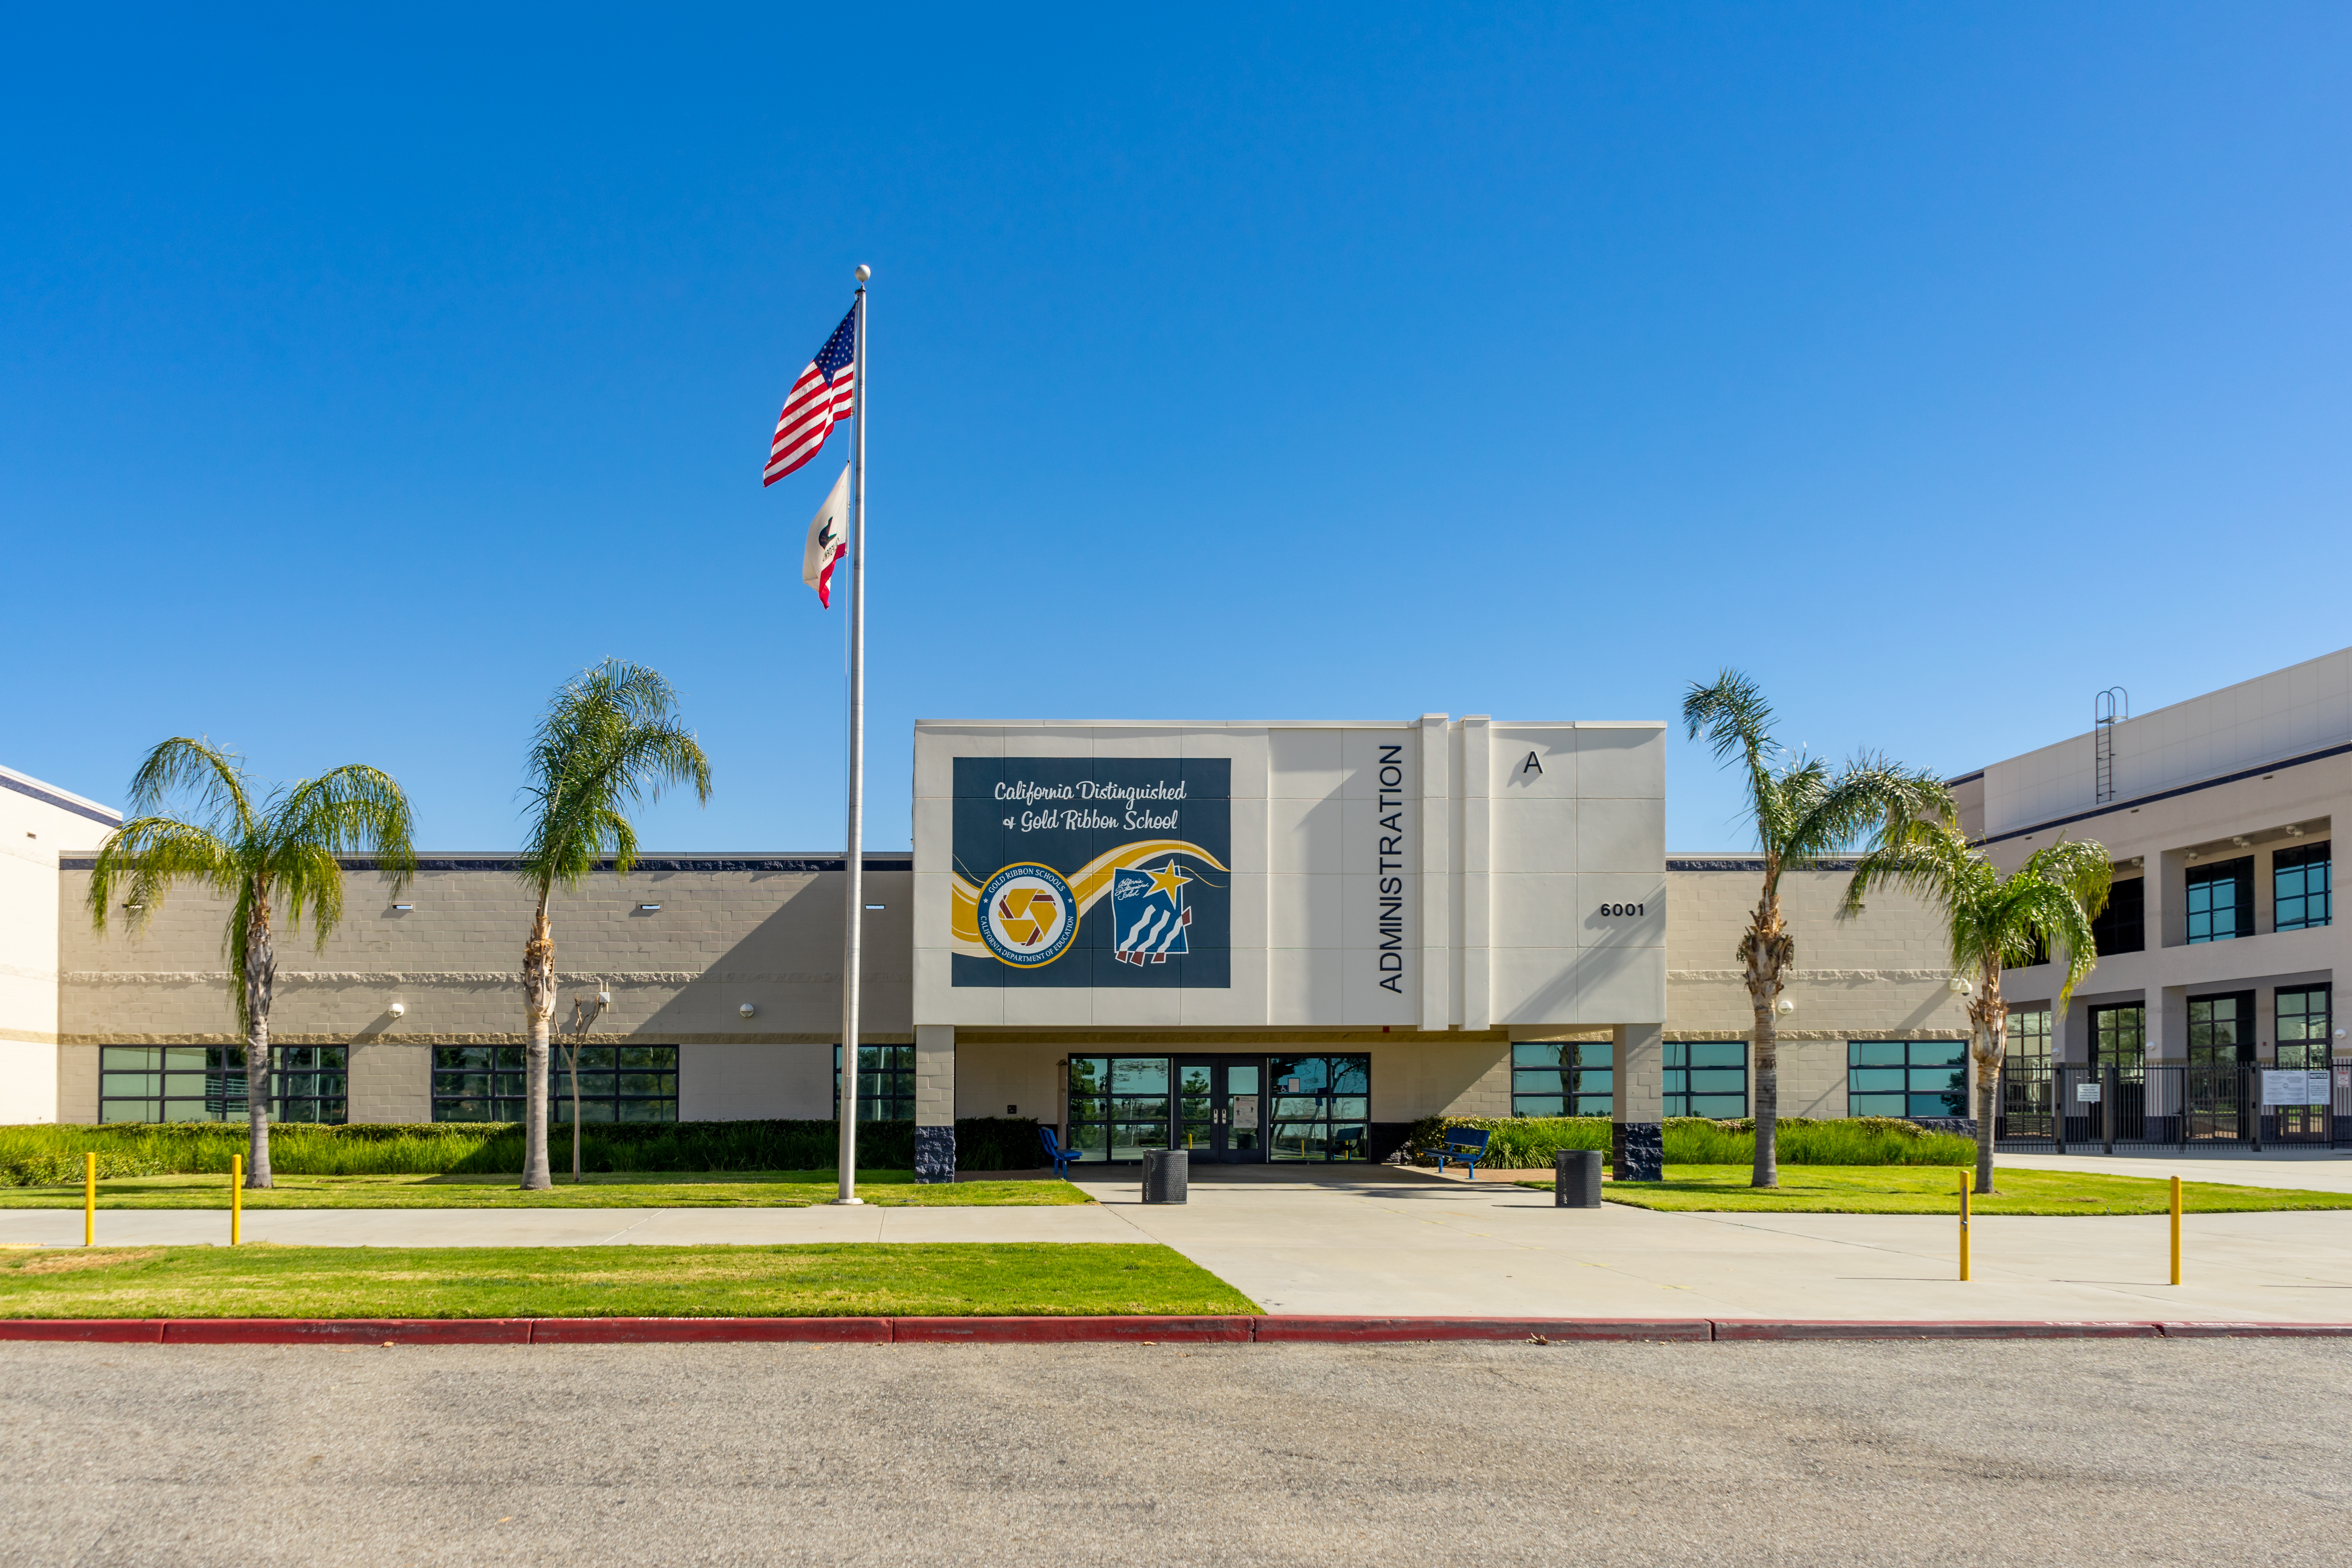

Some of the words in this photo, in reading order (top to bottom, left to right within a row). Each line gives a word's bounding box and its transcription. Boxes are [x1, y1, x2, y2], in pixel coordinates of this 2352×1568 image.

[1523, 751, 1543, 773] A
[995, 780, 1074, 806] California
[1076, 780, 1187, 810] Distinguished
[1003, 817, 1016, 829] &
[1021, 809, 1059, 832] Gold
[1060, 809, 1119, 830] Ribbon
[1123, 809, 1178, 830] School
[988, 876, 1005, 893] GOLD
[1005, 868, 1034, 879] RIBBON
[1035, 869, 1065, 891] SCHOOLS
[1379, 746, 1402, 994] ADMINISTRATION
[1118, 878, 1143, 889] California
[1118, 889, 1140, 900] School
[1601, 903, 1643, 916] 6001
[981, 916, 1002, 953] CALIFORNIA
[1002, 949, 1044, 962] DEPARTMENT
[1053, 916, 1074, 951] EDUCATION
